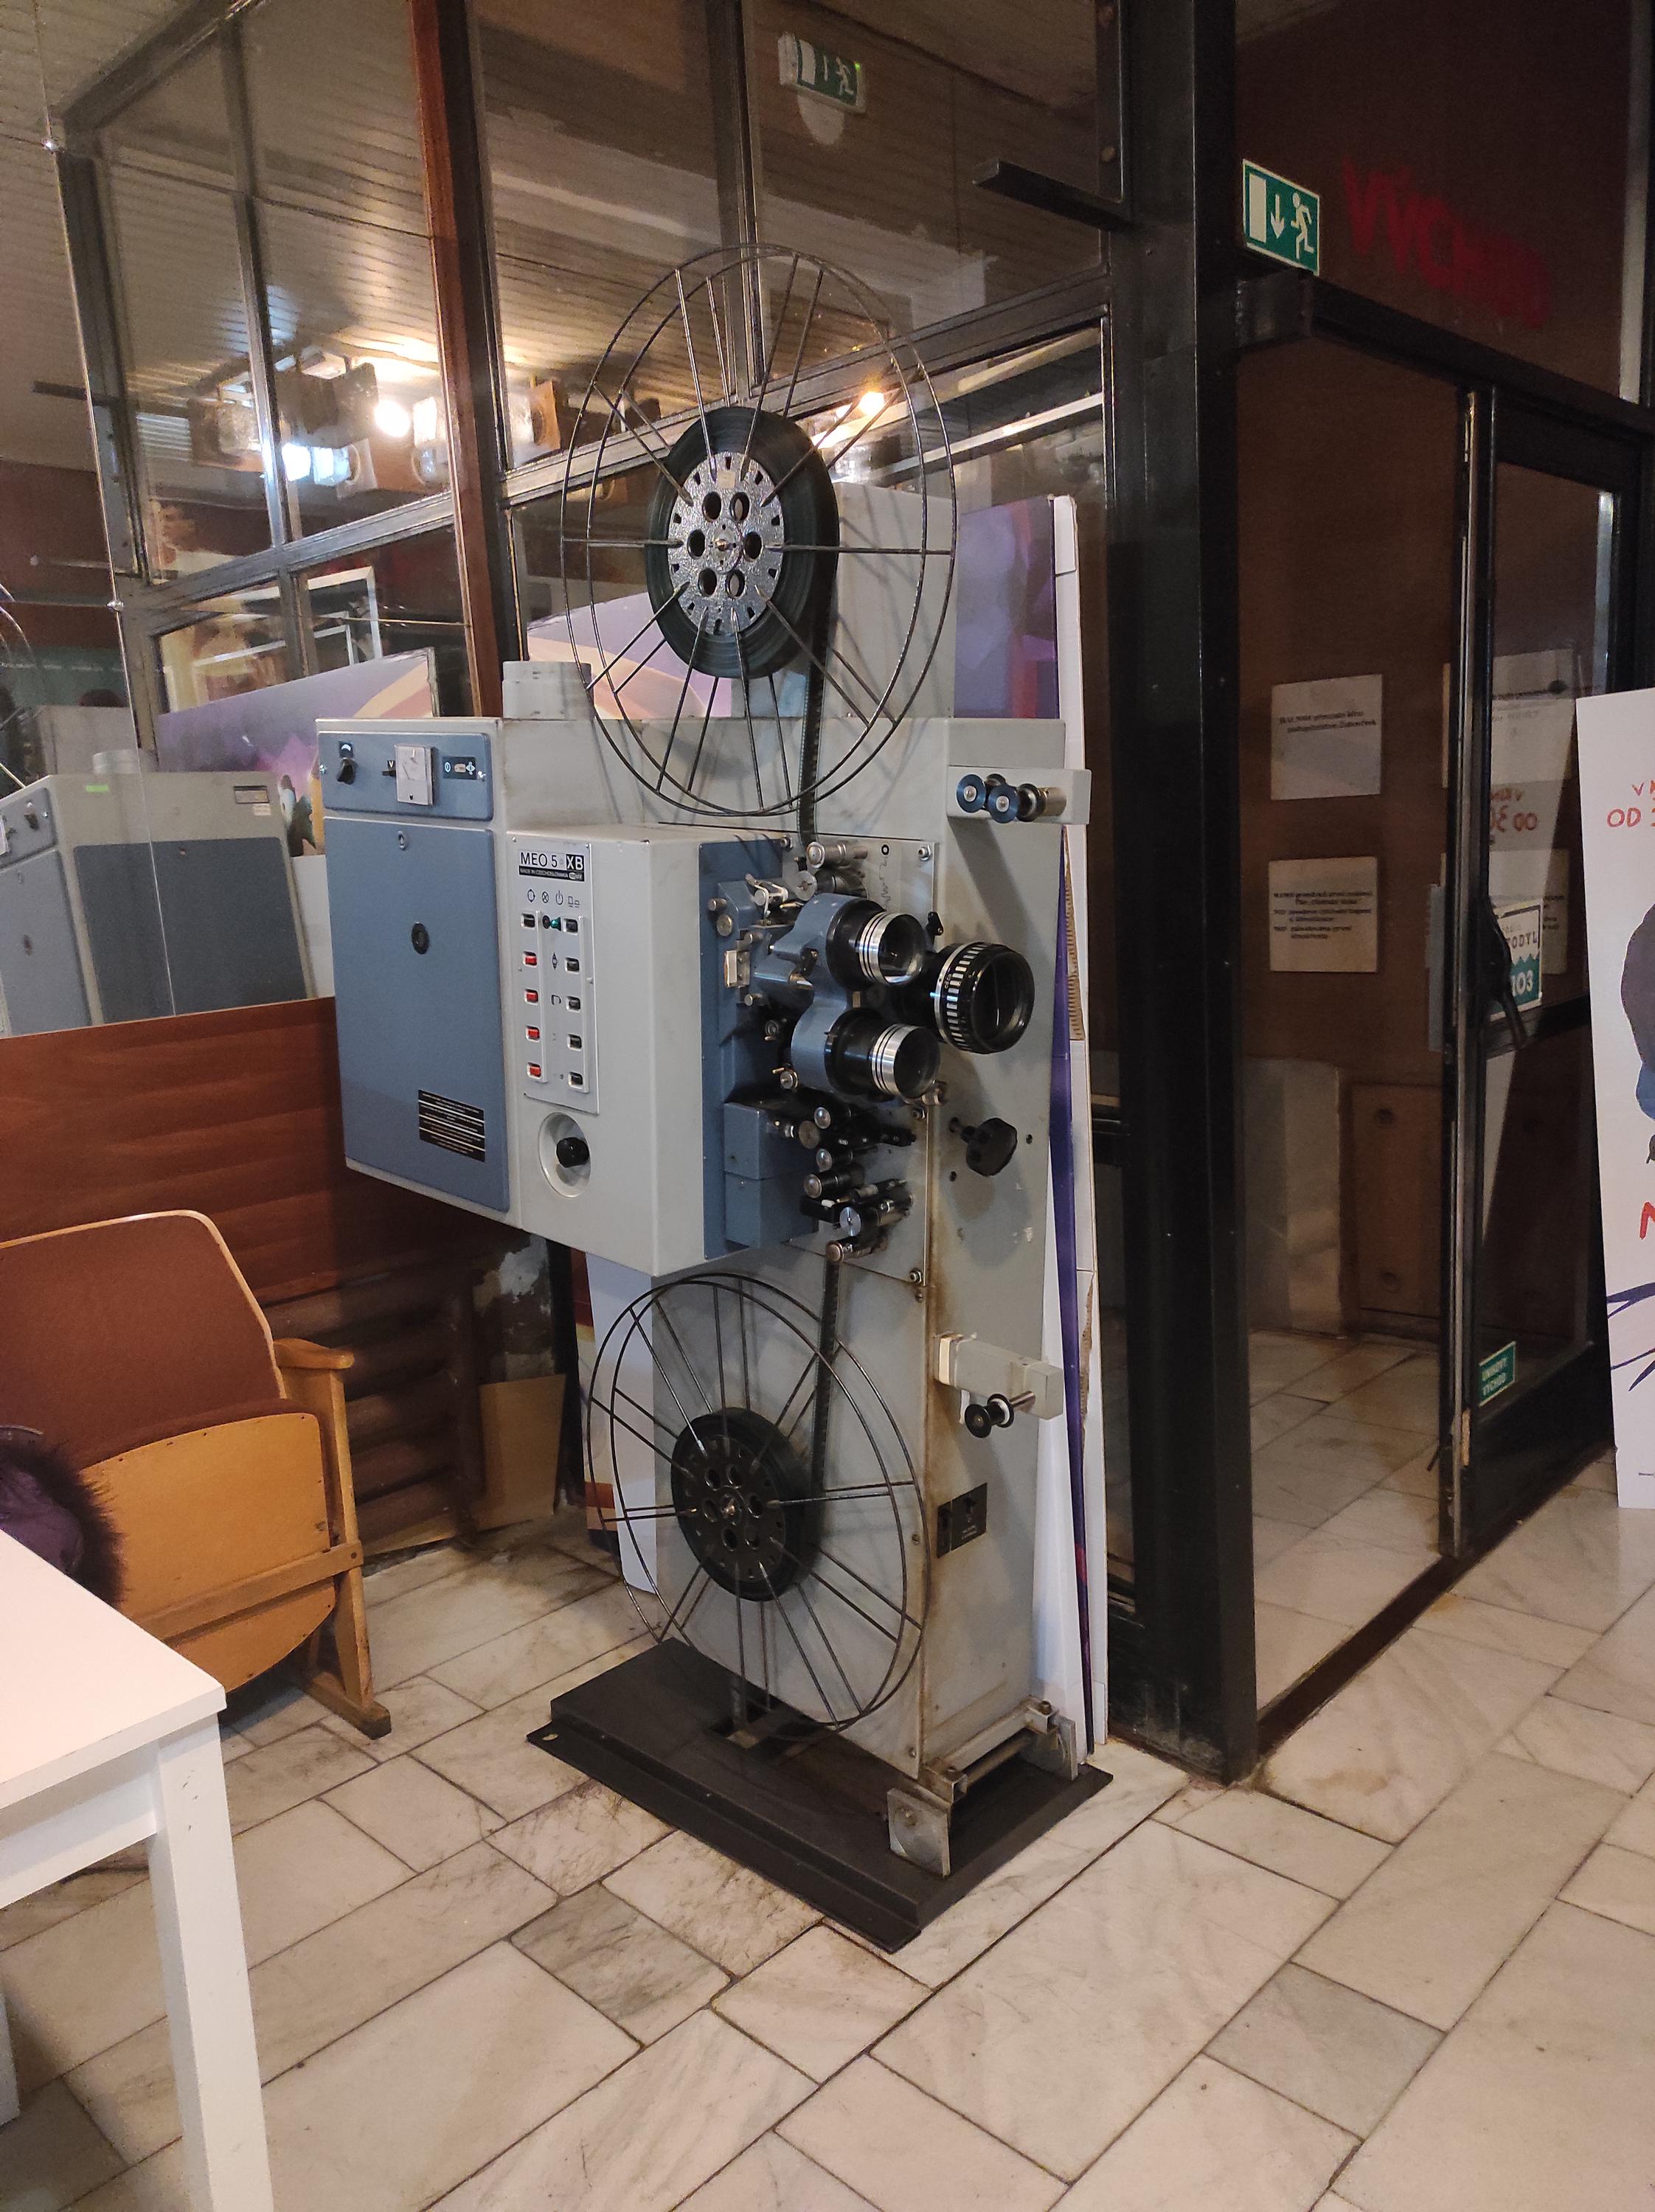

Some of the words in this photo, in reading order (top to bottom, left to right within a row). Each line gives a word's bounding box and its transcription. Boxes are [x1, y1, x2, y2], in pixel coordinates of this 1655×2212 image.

[1631, 782, 1644, 796] V
[1607, 807, 1641, 827] OD
[521, 852, 548, 867] MEO
[551, 855, 558, 868] 5
[566, 855, 583, 870] XB
